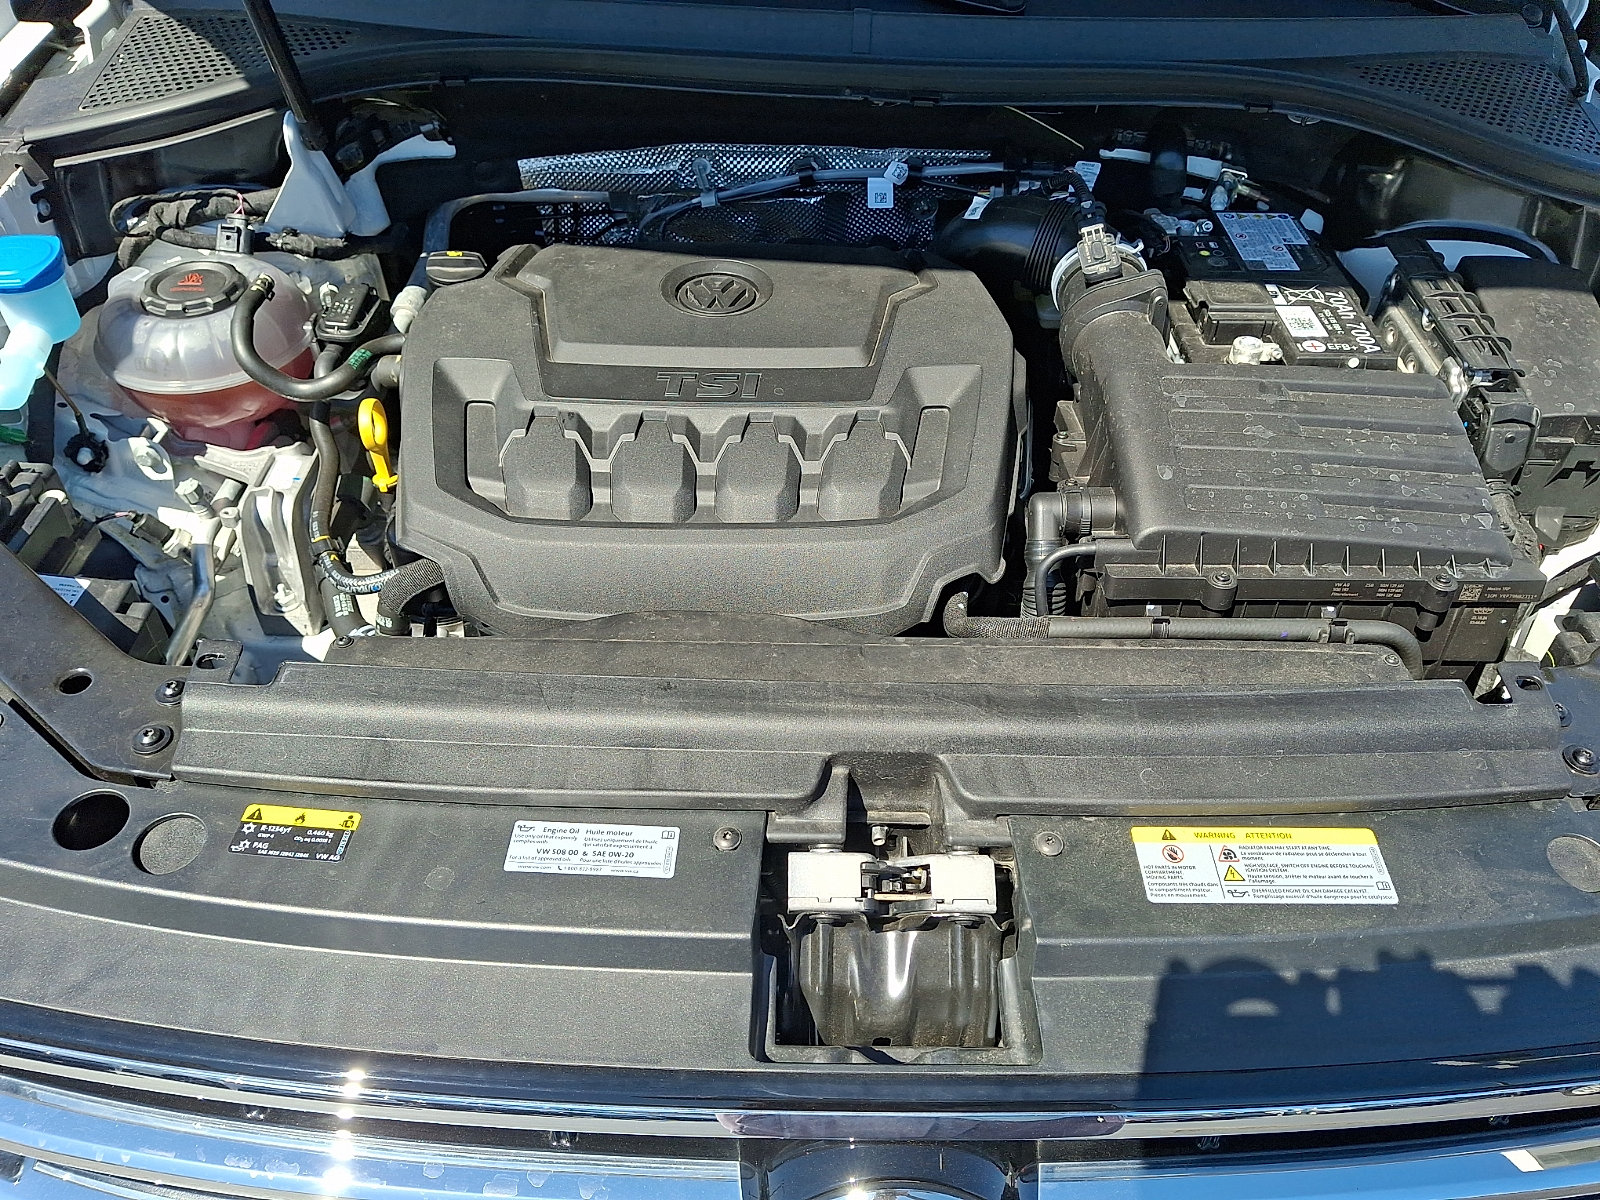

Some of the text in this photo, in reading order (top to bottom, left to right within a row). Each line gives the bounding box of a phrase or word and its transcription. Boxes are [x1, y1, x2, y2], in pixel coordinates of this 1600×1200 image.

[1325, 291, 1356, 319] 70Ah
[1346, 323, 1382, 354] 700A
[656, 372, 762, 398] TSI
[260, 825, 292, 834] R-1234yf
